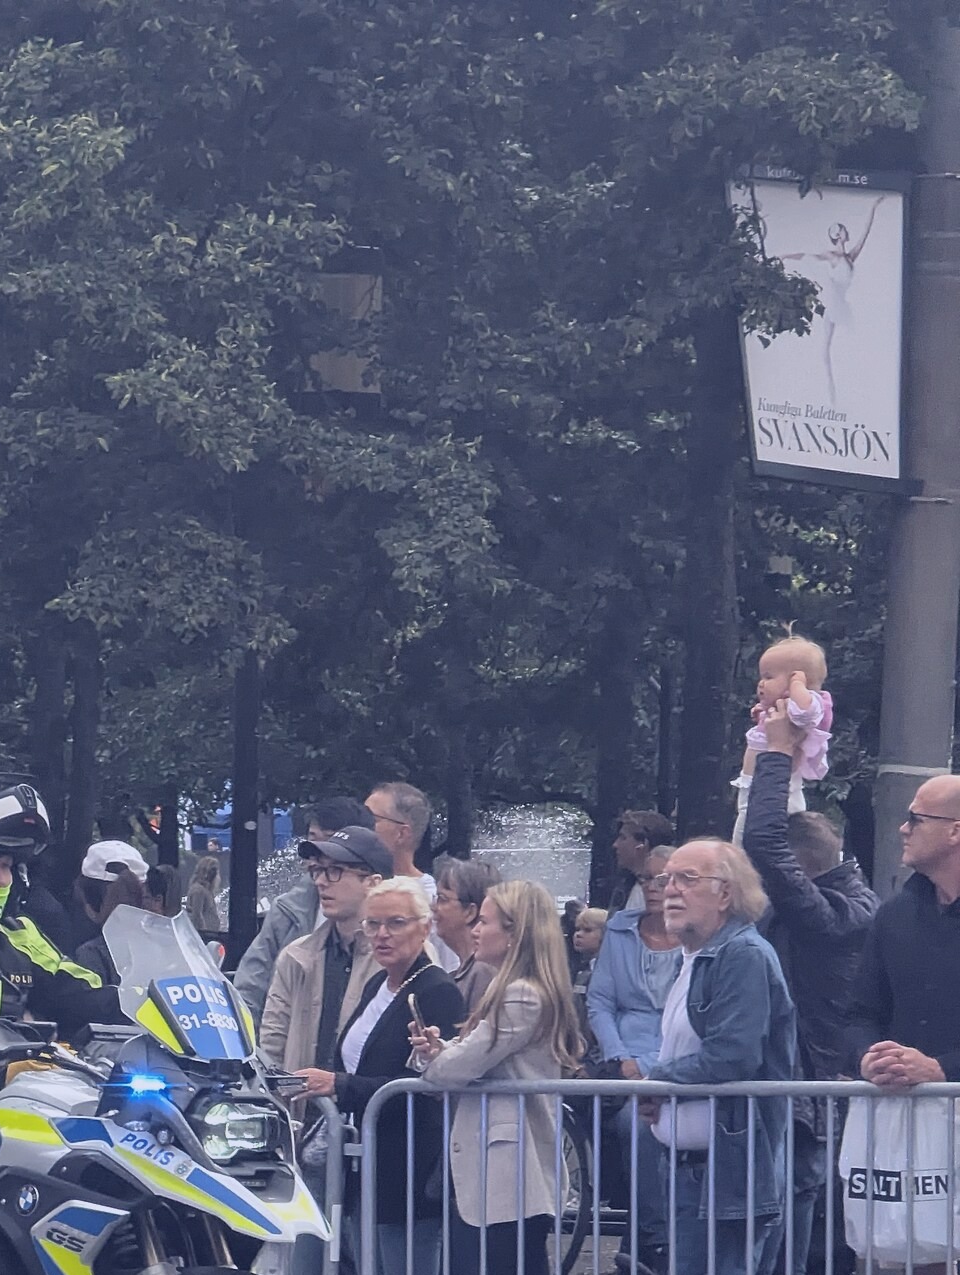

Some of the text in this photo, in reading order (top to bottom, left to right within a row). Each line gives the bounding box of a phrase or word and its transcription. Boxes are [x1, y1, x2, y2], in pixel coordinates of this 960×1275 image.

[757, 397, 847, 422] Kungliga Baletten
[758, 416, 892, 462] SVANSJÖN
[166, 983, 228, 1007] POLIS
[120, 1133, 175, 1165] POLIS
[46, 1228, 87, 1252] GS
